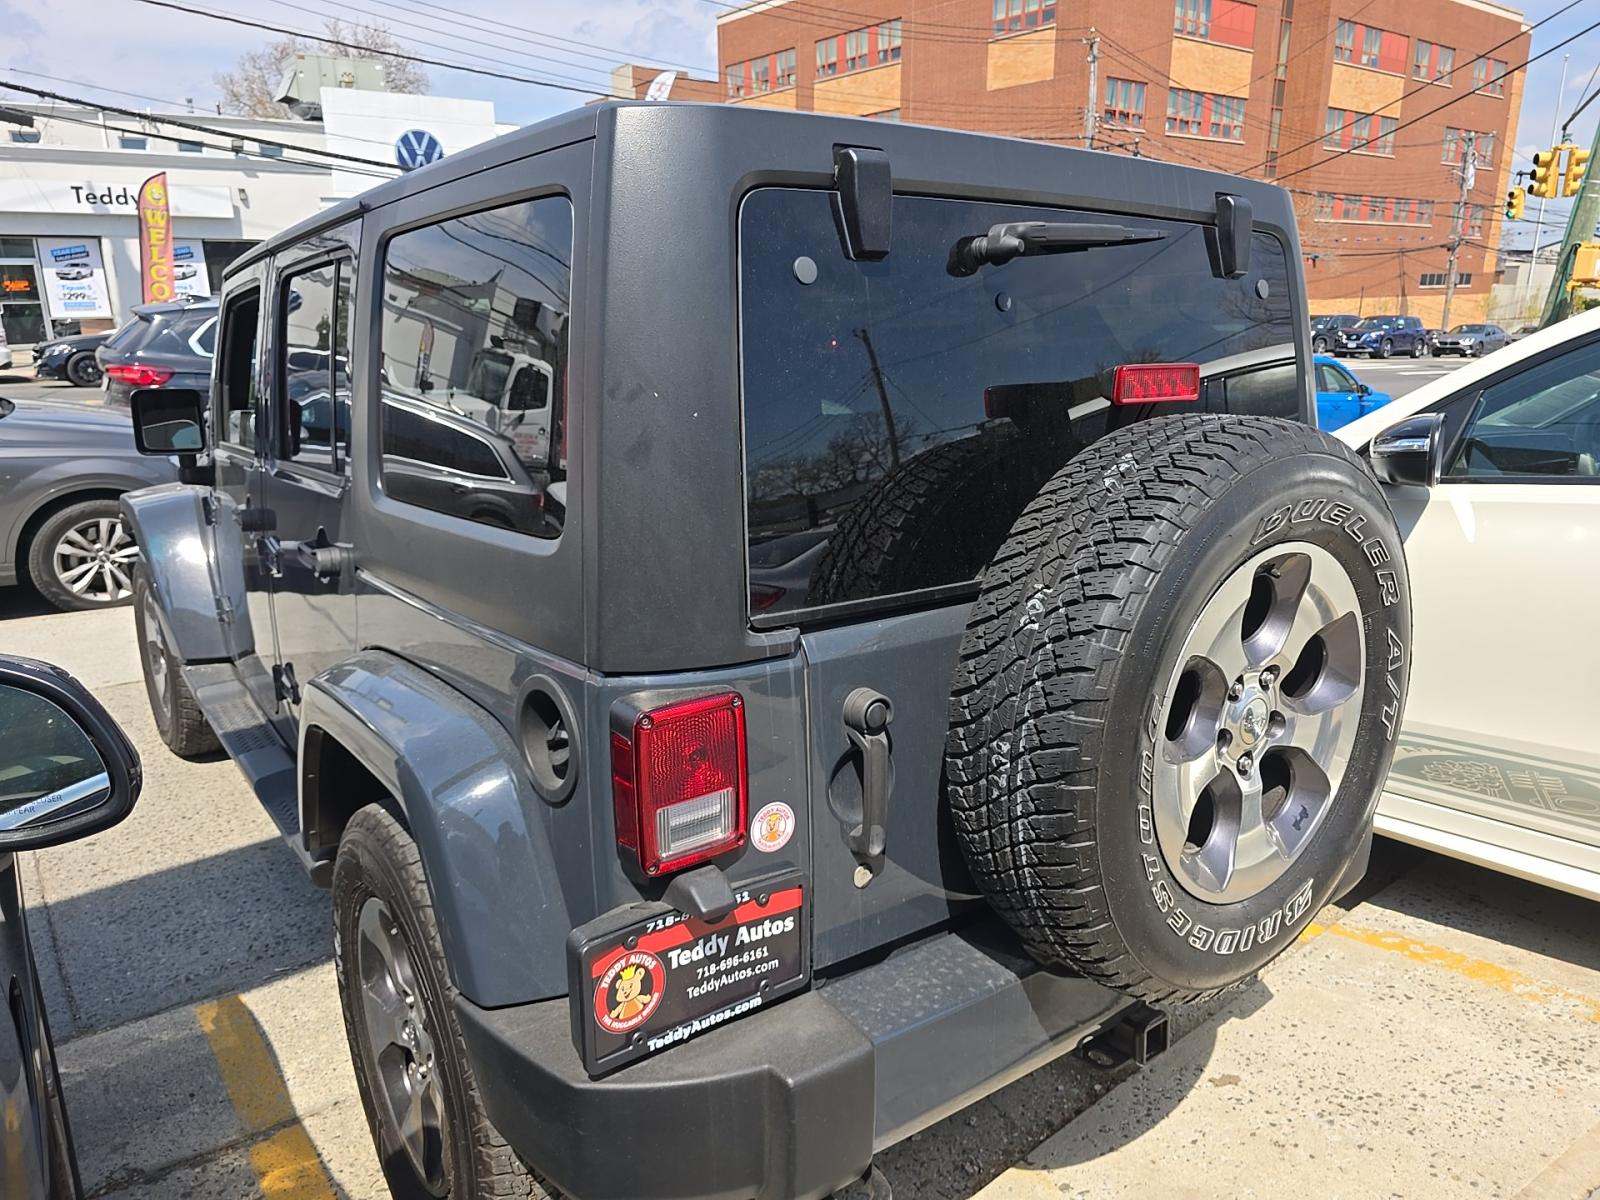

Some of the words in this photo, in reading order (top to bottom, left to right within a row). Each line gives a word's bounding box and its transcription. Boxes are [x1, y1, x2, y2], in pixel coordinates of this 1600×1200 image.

[143, 207, 172, 303] WELCO
[1251, 499, 1400, 607] DUELER
[1380, 627, 1403, 741] A/T
[668, 933, 729, 970] Teddy
[735, 915, 795, 946] Autos
[696, 945, 769, 980] 718-696-6161
[601, 957, 627, 988] TEDDY
[629, 953, 657, 970] AUTOS
[687, 958, 779, 1000] TeddyAutos.com
[647, 995, 763, 1052] TeddyAutos.com
